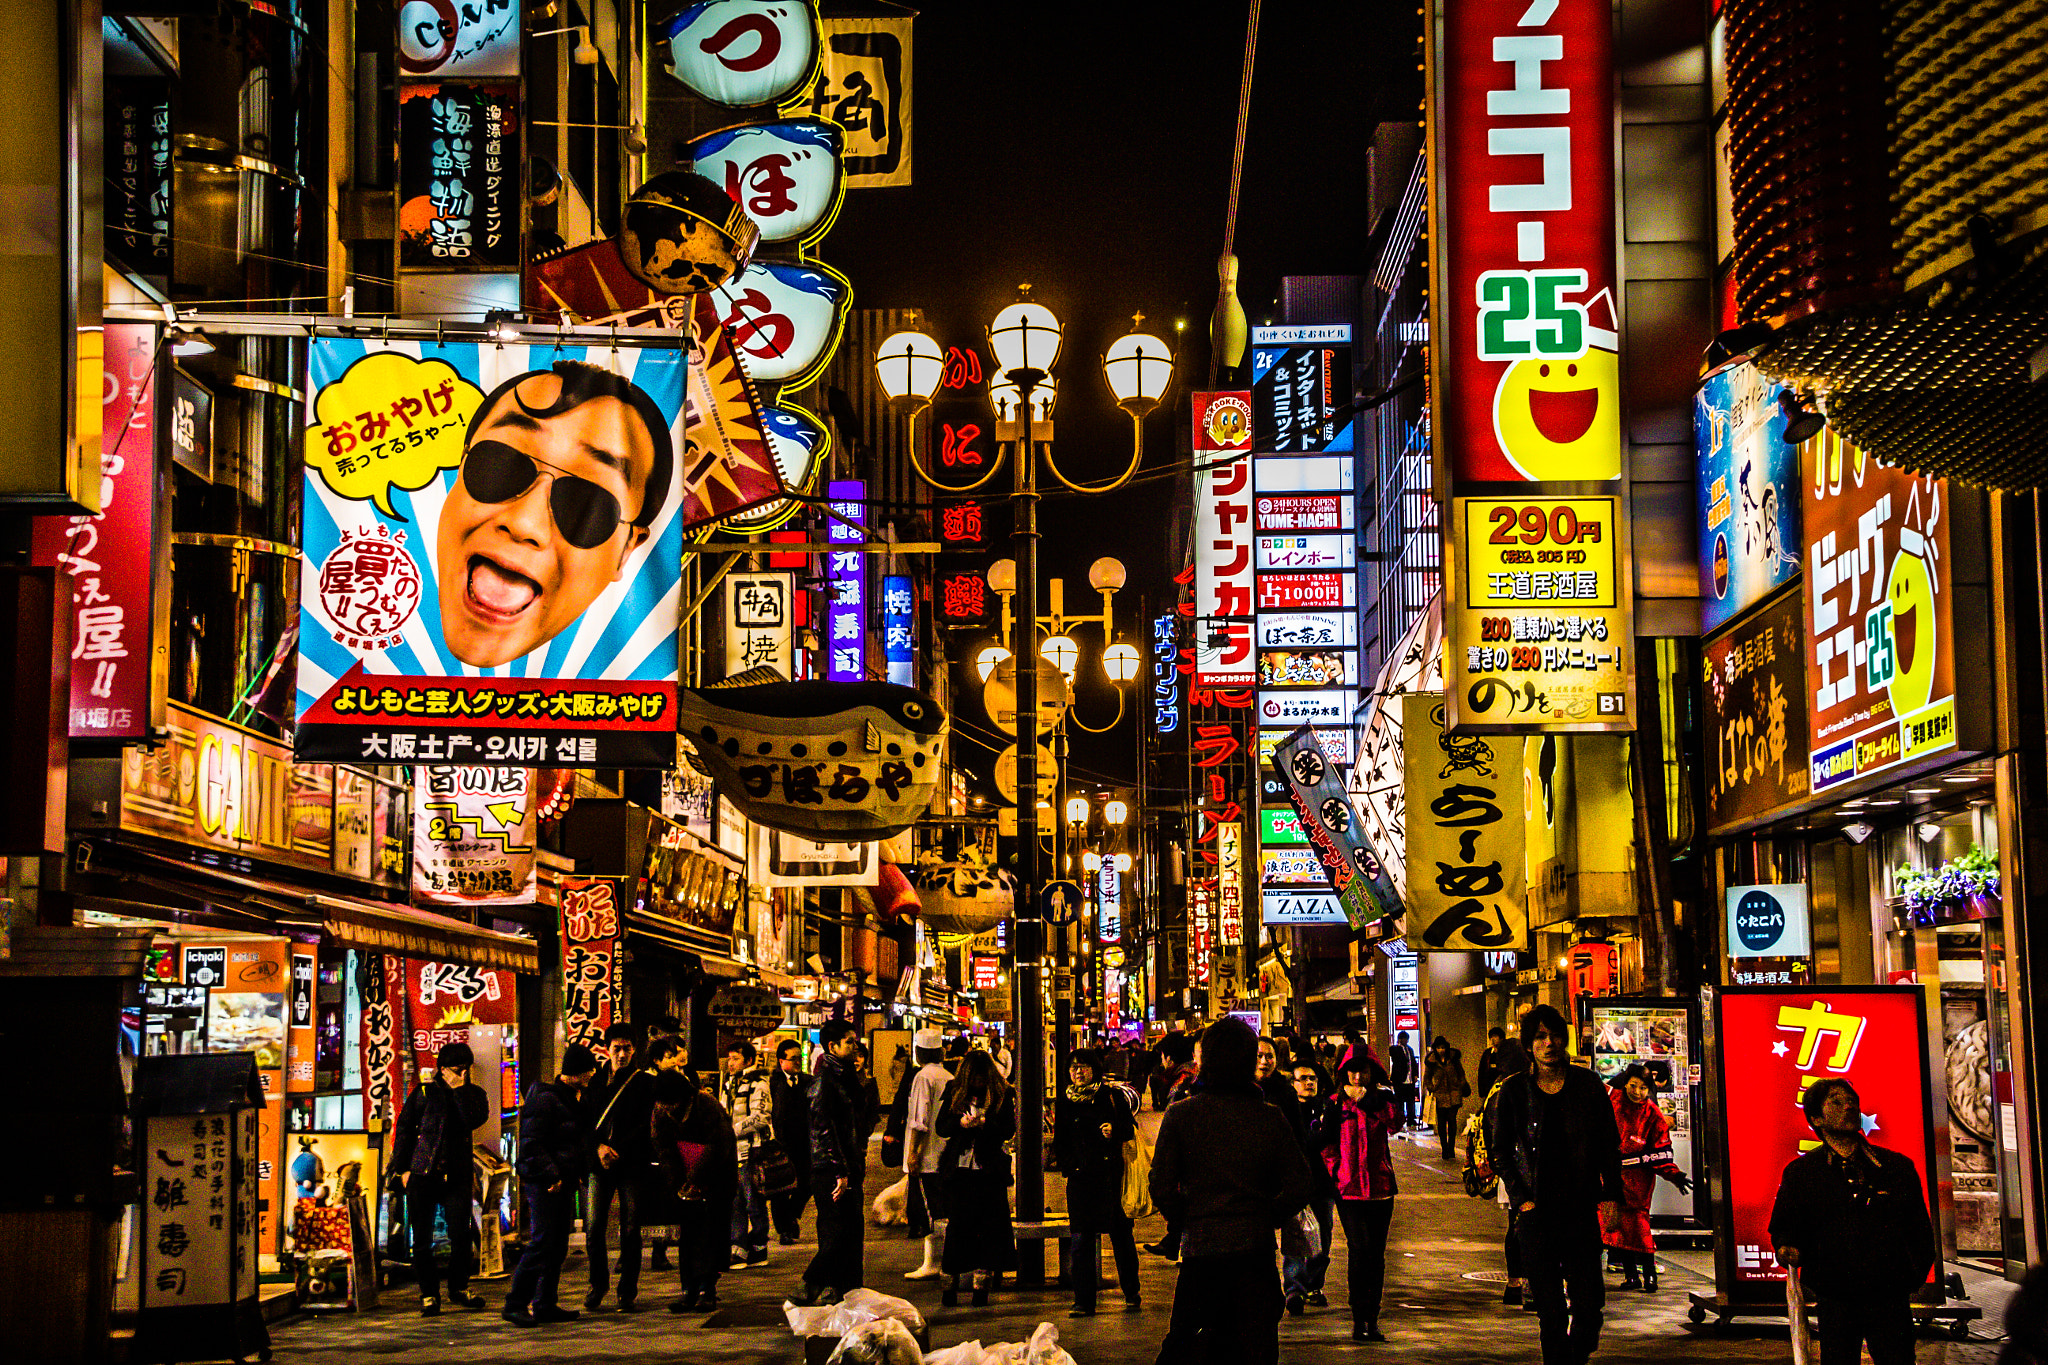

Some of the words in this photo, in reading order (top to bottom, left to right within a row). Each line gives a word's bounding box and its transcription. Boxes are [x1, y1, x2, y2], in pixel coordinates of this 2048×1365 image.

[431, 98, 474, 257] 海鮮物語
[1479, 270, 1586, 358] 25
[1256, 352, 1273, 369] 2F
[128, 337, 149, 428] よしもと
[1296, 350, 1316, 450] インターネット
[322, 379, 455, 457] おみやげ
[1708, 405, 1724, 456] 1F
[1345, 469, 1351, 478] 6
[1273, 499, 1312, 508] 24HOURS
[1313, 499, 1337, 508] OPEN
[340, 524, 406, 544] よしもと
[1259, 513, 1338, 529] YUME-HACHI
[1489, 505, 1601, 545] 290円
[1262, 538, 1307, 548] カラオケ
[1269, 551, 1336, 566] レインボー
[1811, 492, 1892, 637] ビッグ
[1260, 583, 1282, 608] 占
[1285, 586, 1340, 600] 1000円
[1488, 570, 1598, 599] 王道居酒屋
[741, 589, 779, 618] 牛角
[884, 590, 912, 649] 焼肉
[1481, 616, 1510, 640] 200
[1512, 616, 1607, 641] 種類から選べる
[741, 634, 779, 662] 焼
[1467, 645, 1508, 672] 驚きの
[1511, 646, 1541, 670] 290
[1724, 626, 1776, 686] 海鮮居酒屋
[1816, 624, 1867, 714] エコー
[1867, 602, 1895, 690] 25
[1154, 614, 1179, 732] ボウリング
[334, 686, 663, 719] よしもと芸人グッズ・大阪みやげ
[1283, 707, 1340, 717] まるかみ水産
[1599, 695, 1625, 713] B1
[1718, 673, 1788, 796] はなの舞
[556, 736, 599, 763] 선물
[739, 762, 912, 804] づぼらや
[1422, 783, 1515, 949] らーめん
[424, 870, 513, 891] 海鮮物語
[1277, 898, 1335, 914] ZAZA
[1791, 961, 1807, 973] 2F
